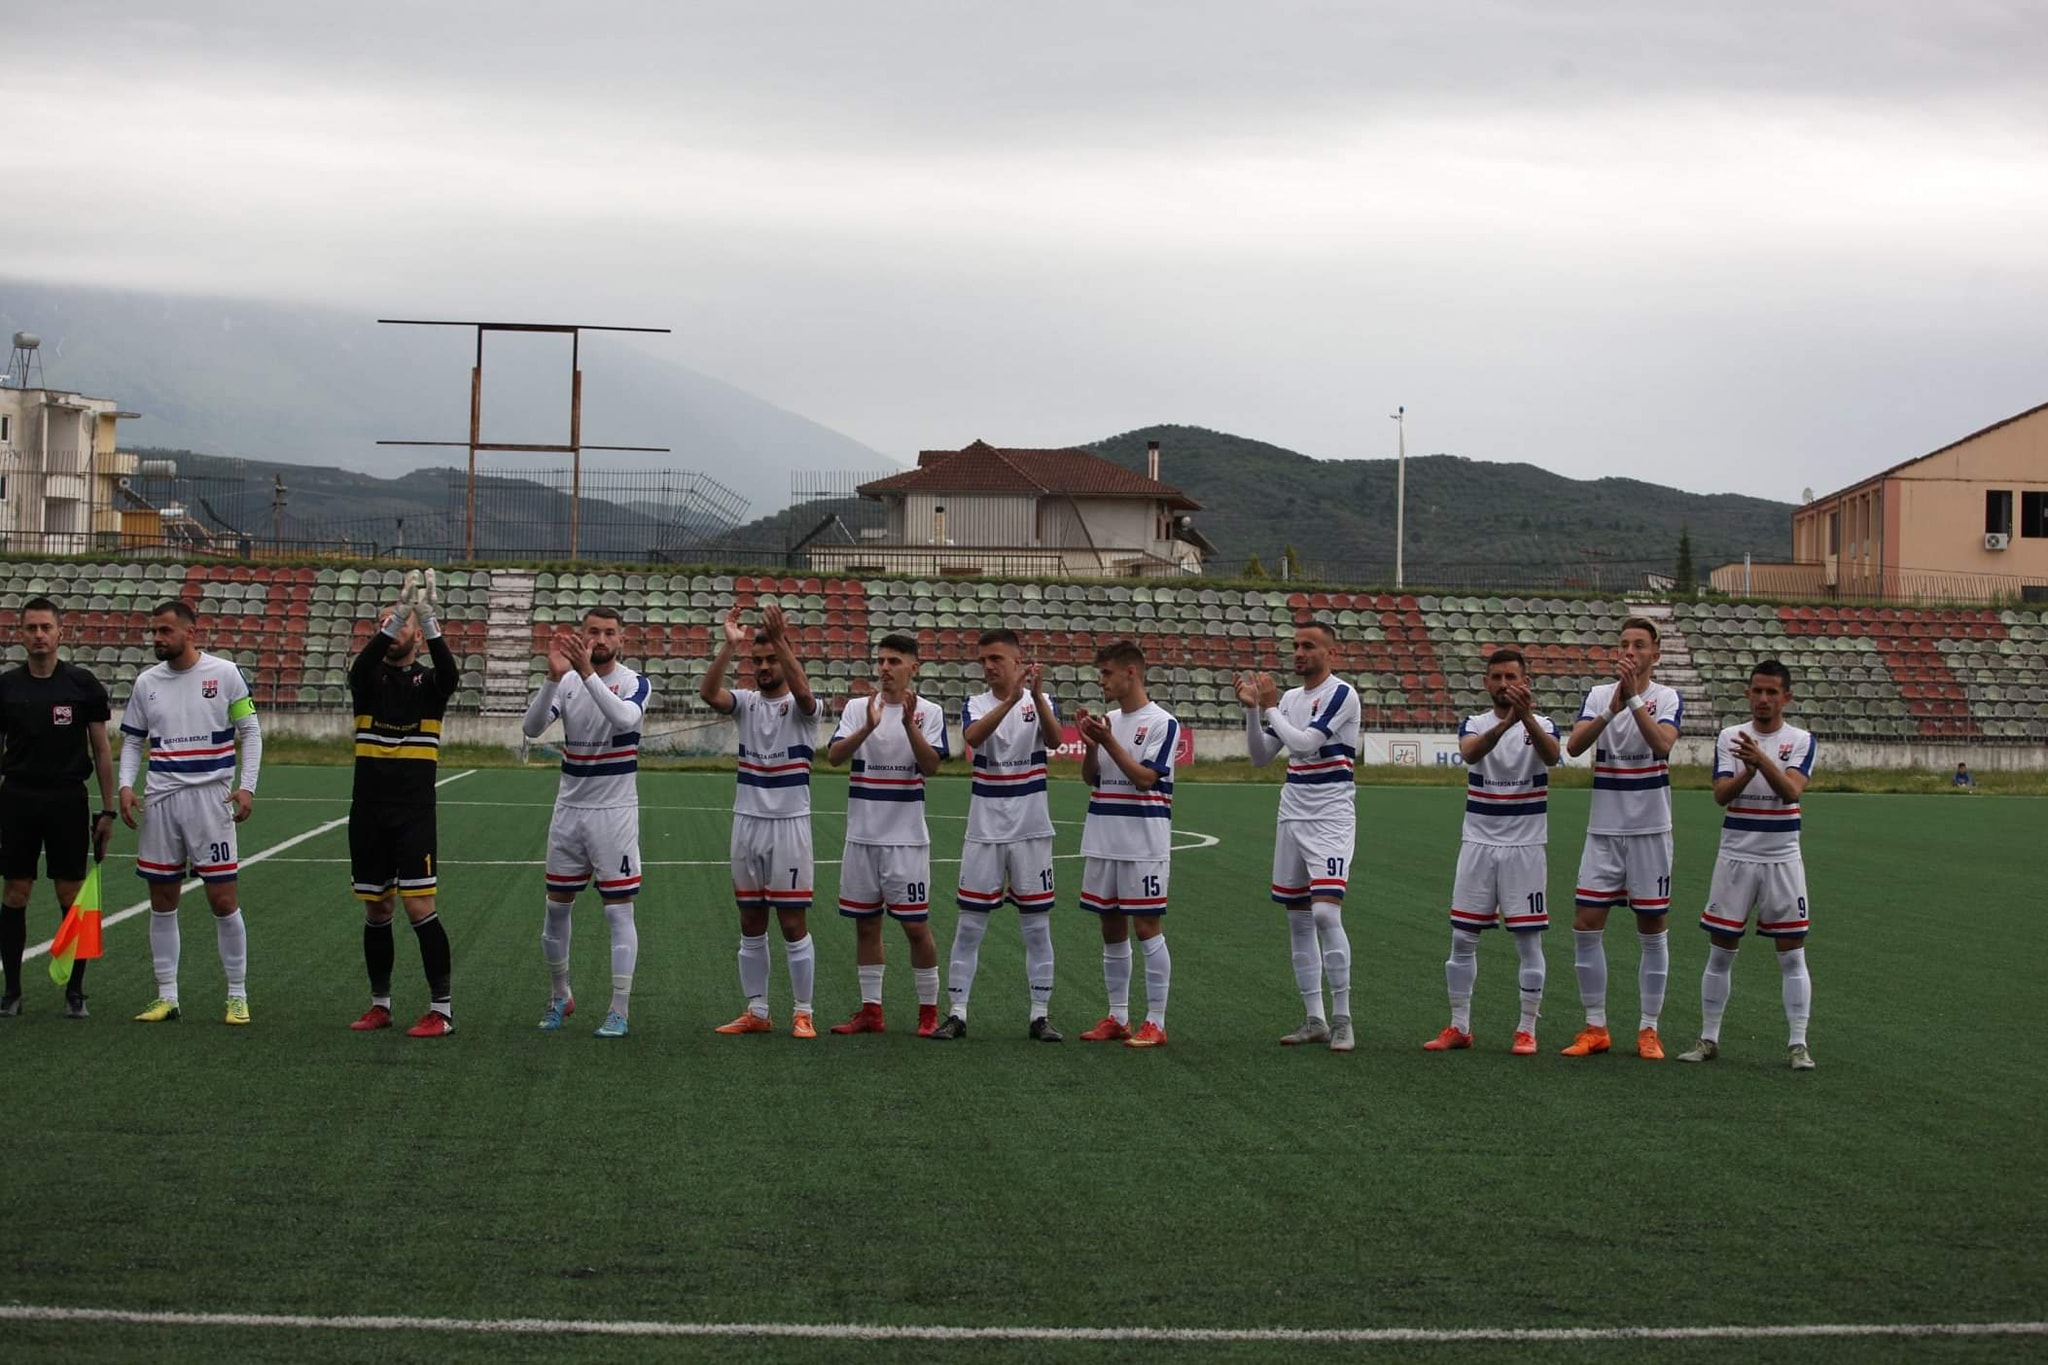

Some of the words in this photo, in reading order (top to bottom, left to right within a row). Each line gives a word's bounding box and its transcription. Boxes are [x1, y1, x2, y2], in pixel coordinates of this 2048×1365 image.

[210, 842, 230, 863] 30
[424, 853, 431, 876] 1
[620, 855, 631, 877] 4
[1327, 857, 1344, 877] 97
[789, 868, 798, 890] 7
[1039, 868, 1053, 891] 13
[1142, 875, 1160, 897] 15
[1657, 875, 1670, 897] 11
[907, 882, 926, 903] 99
[1527, 891, 1544, 914] 10
[1797, 896, 1806, 919] 9
